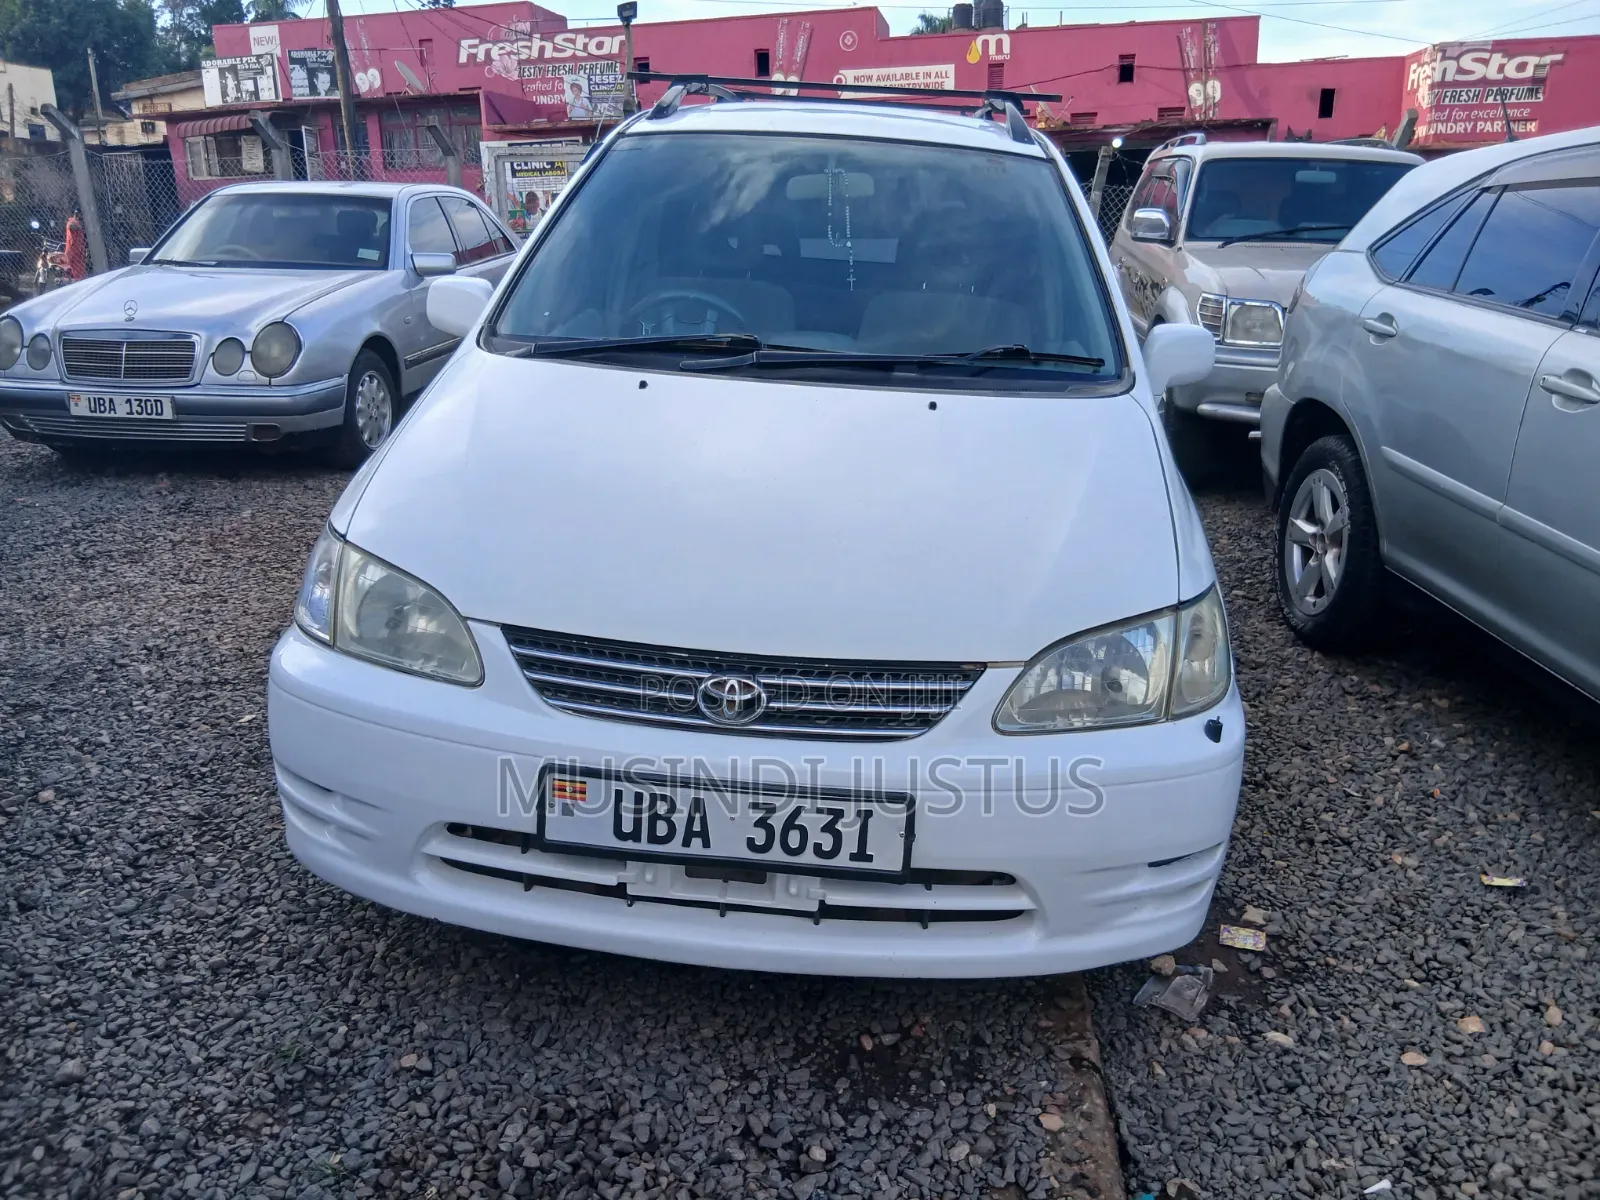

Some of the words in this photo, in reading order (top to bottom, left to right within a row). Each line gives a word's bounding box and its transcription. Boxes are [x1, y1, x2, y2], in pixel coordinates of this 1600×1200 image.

[253, 36, 278, 47] NEW!
[459, 33, 626, 63] FreshStar
[202, 57, 241, 67] ADORABLE
[517, 66, 543, 78] ZESTY
[546, 64, 574, 77] FRESH
[578, 61, 619, 75] PERFUME
[853, 74, 873, 83] NOW
[876, 72, 920, 82] AVAILABLE
[923, 71, 931, 79] IN
[934, 70, 950, 79] ALL
[1407, 52, 1564, 91] FreshStar
[554, 79, 566, 92] fo
[1442, 88, 1481, 103] FRESH
[1485, 87, 1542, 102] PERFUME
[1451, 107, 1469, 122] for
[513, 161, 551, 170] CLINIC
[87, 397, 117, 414] UBA
[125, 398, 164, 416] 130D
[612, 788, 711, 850] UBA
